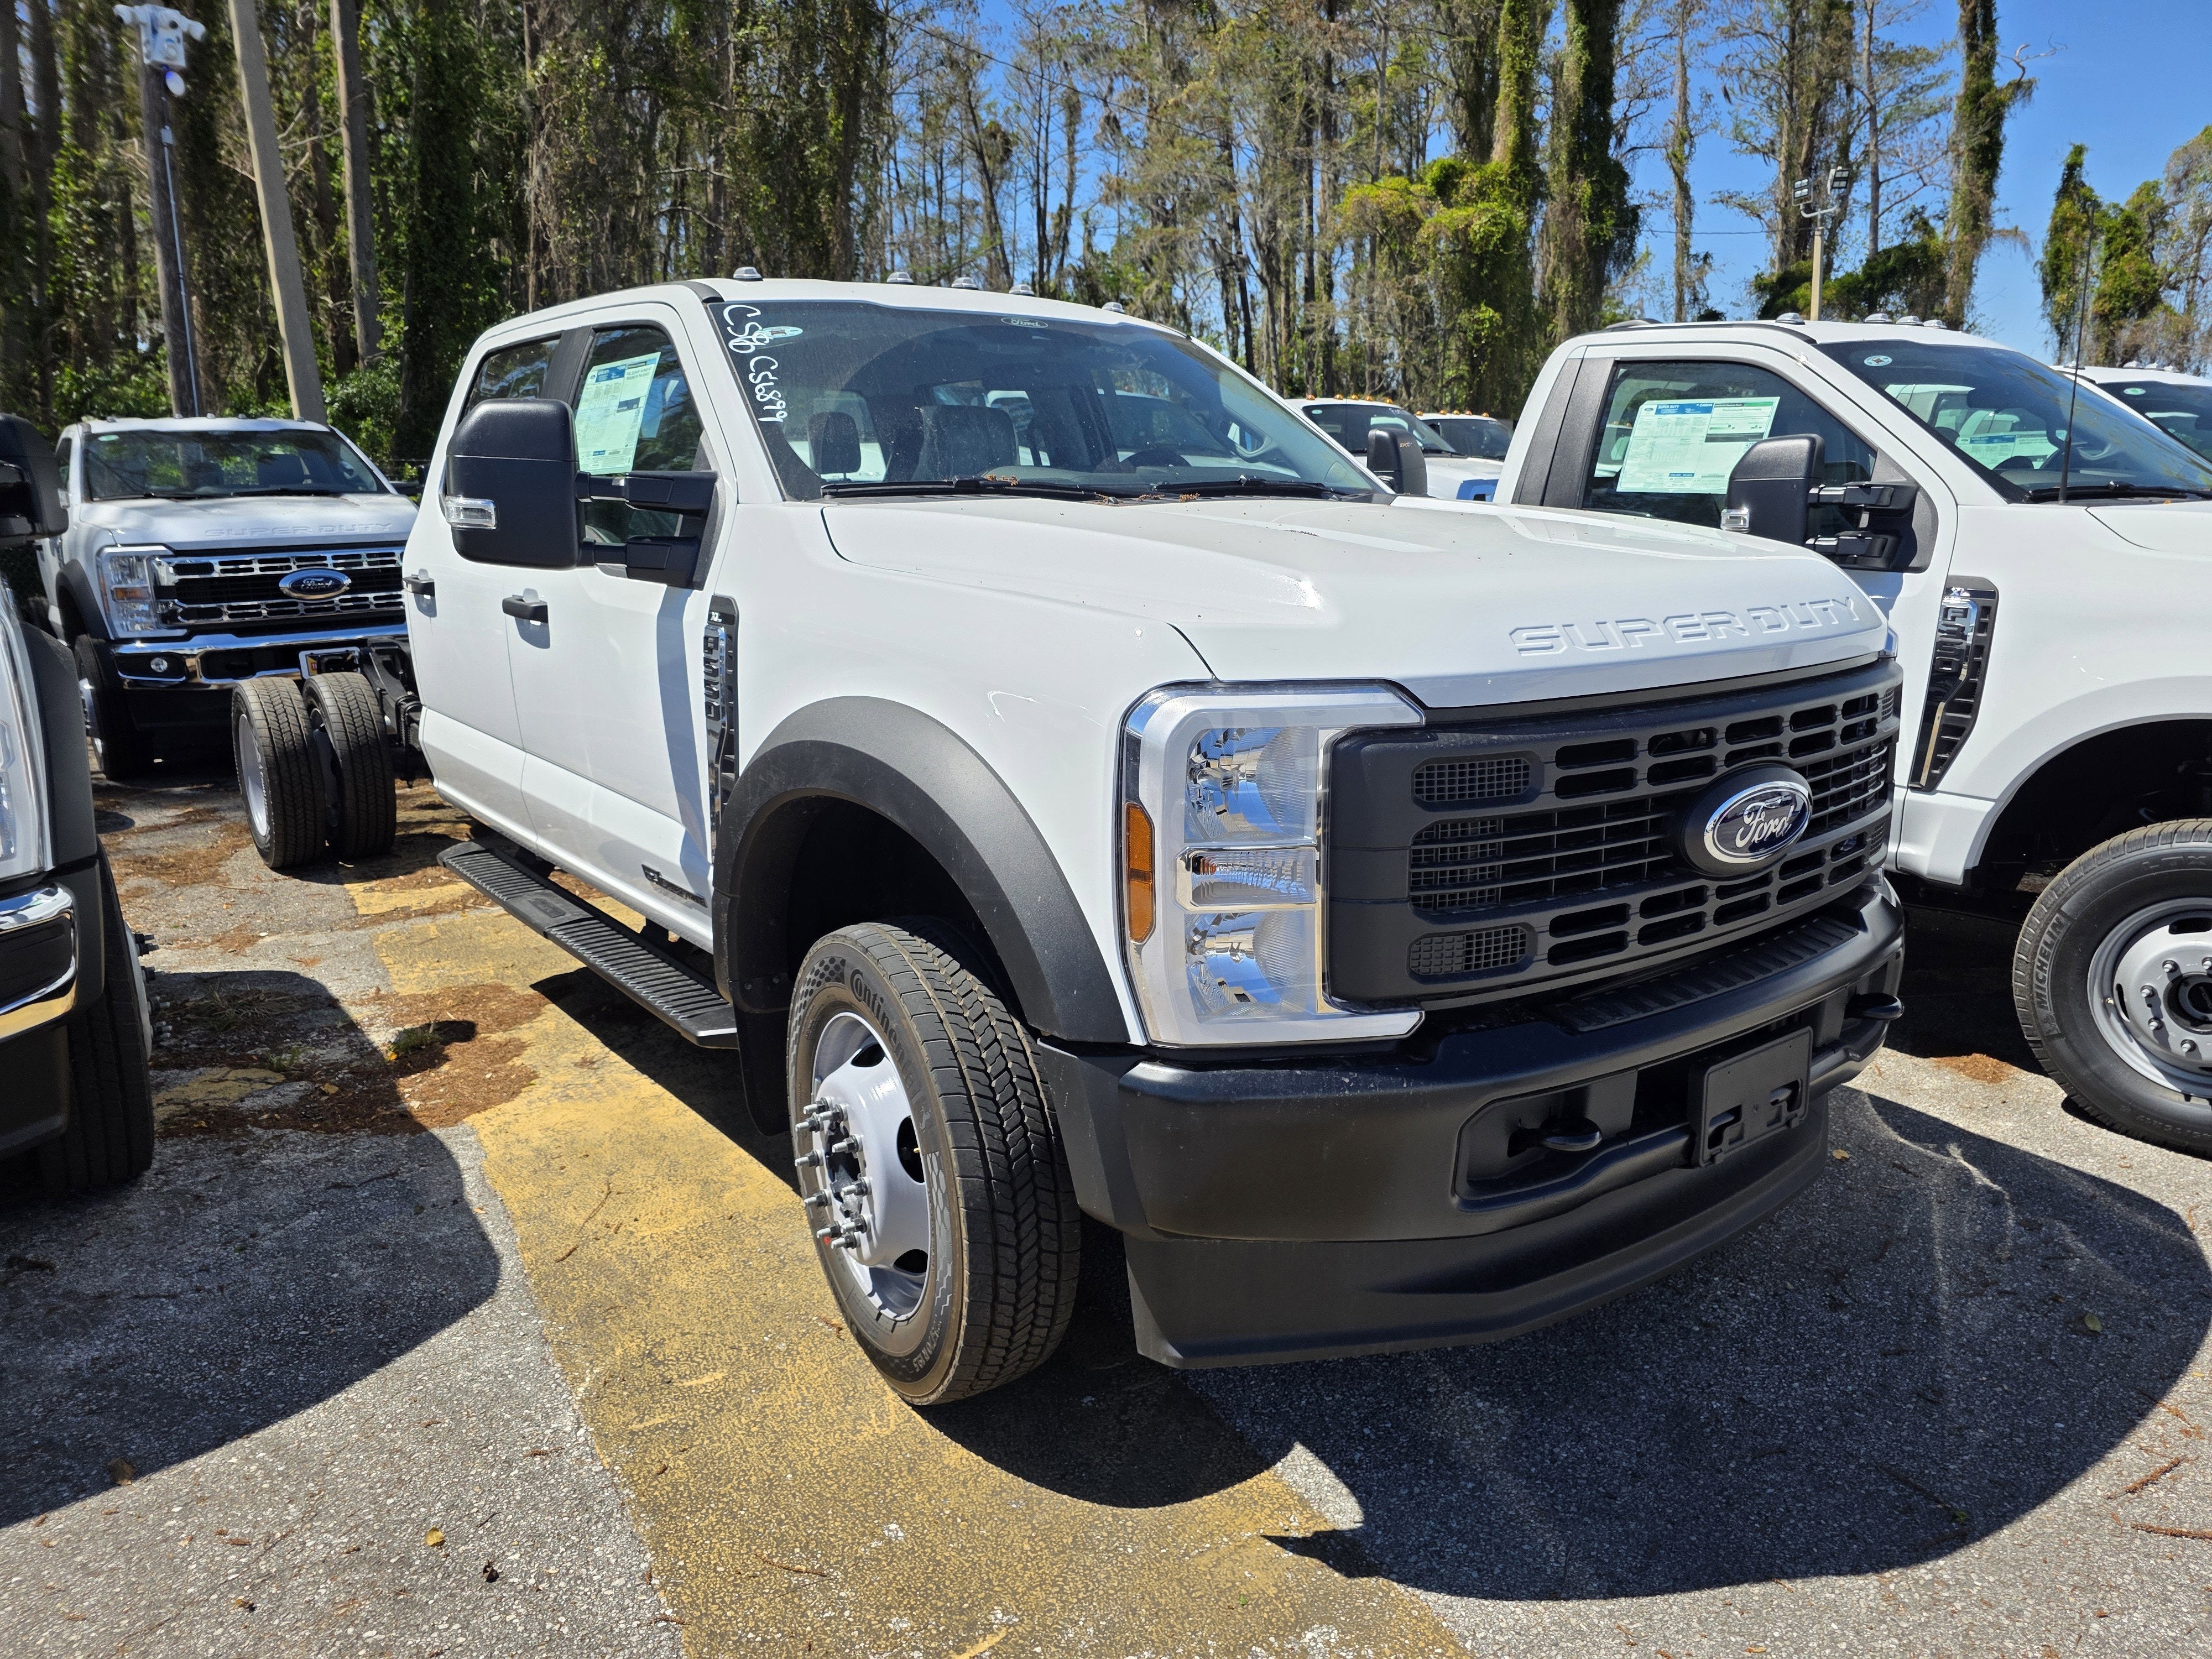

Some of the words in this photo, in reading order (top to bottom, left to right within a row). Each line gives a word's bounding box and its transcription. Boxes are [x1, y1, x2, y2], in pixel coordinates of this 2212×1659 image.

[1010, 317, 1041, 327] Ford
[205, 526, 313, 538] SUPER
[318, 523, 392, 534] DUTY
[301, 577, 333, 590] Ford
[1509, 611, 1751, 658] SUPER
[1746, 596, 1861, 634] DUTY
[1735, 796, 1794, 848] Ford
[2033, 915, 2072, 1010] MICHELIN
[850, 968, 922, 1104] Continental
